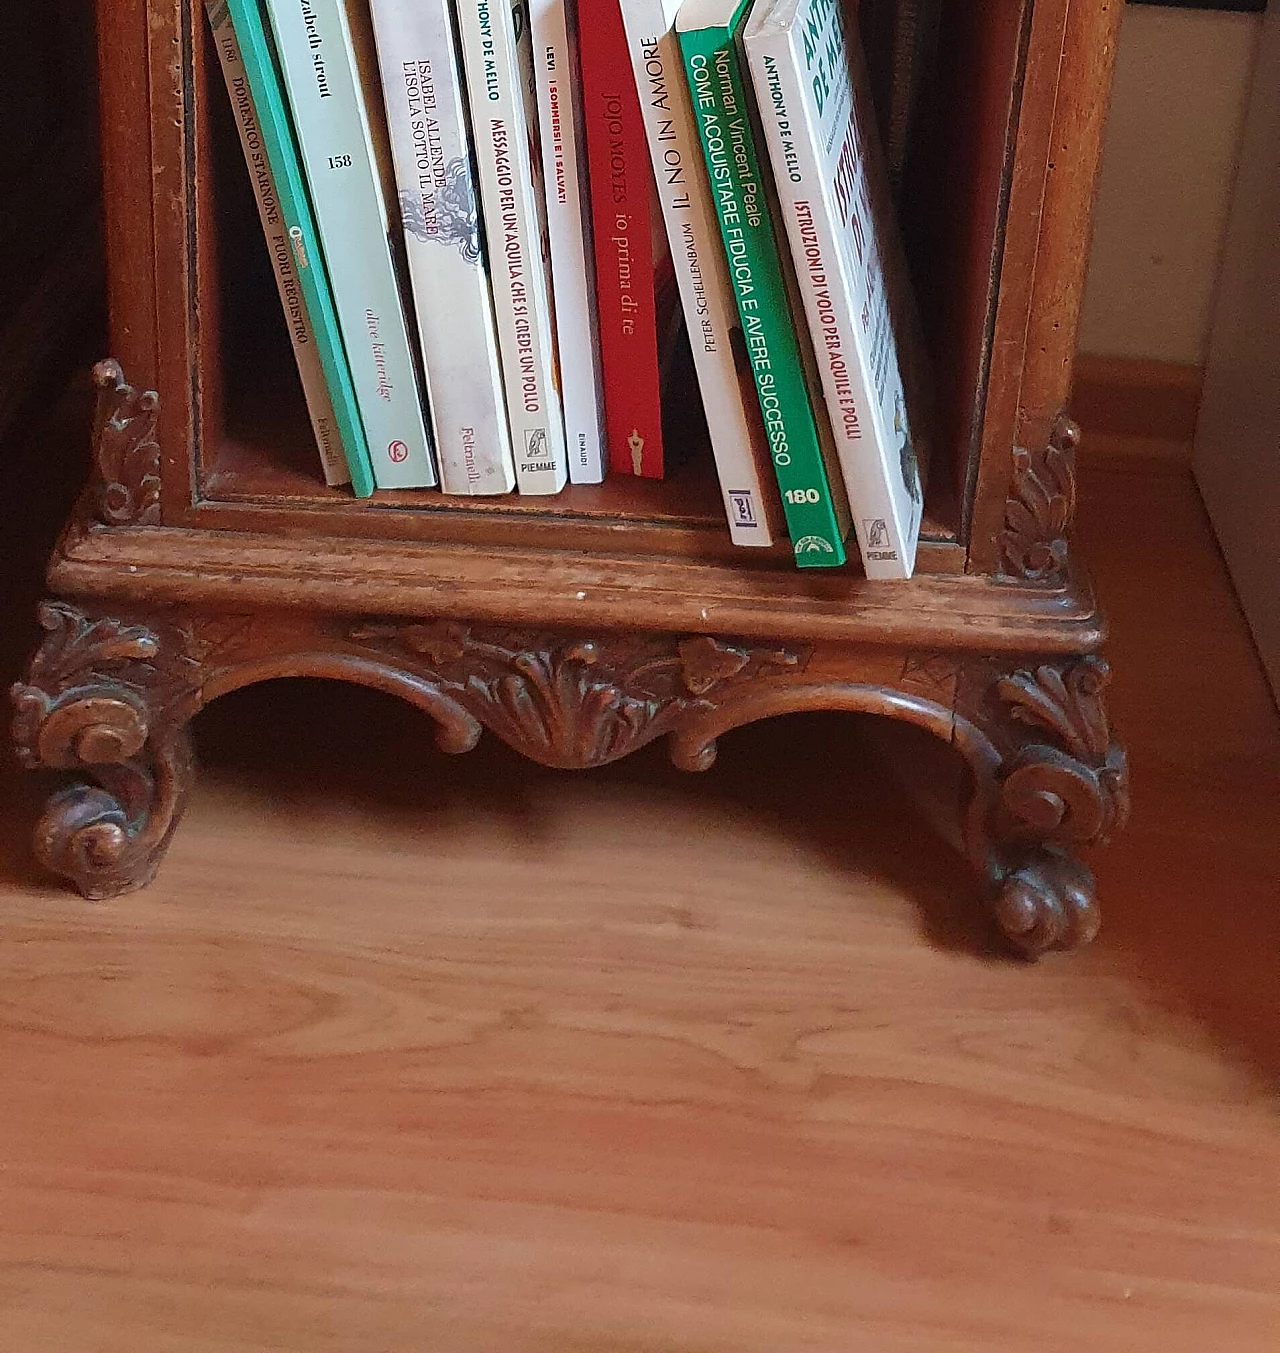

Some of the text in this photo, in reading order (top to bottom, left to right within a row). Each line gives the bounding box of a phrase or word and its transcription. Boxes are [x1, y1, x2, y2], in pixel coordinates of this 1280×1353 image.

[482, 40, 494, 57] DE
[546, 46, 556, 70] LEVI
[312, 53, 332, 99] strout
[484, 60, 500, 101] MELLO
[812, 57, 829, 119] DE
[418, 59, 447, 188] ISABEL ALLENDE
[549, 86, 562, 143] SOMMERSI
[641, 37, 691, 209] IL NO IN AMORE
[714, 49, 761, 227] Norman Vincent Peale
[763, 55, 802, 183] ANTHONY DE MELLO
[327, 155, 352, 169] 158
[403, 61, 439, 235] L'ISOLA SOTTO IL MARE
[555, 161, 567, 204] SALVATI
[231, 76, 260, 152] DOMENICO
[250, 152, 279, 224] STARNONE
[273, 235, 291, 278] FUORI
[283, 279, 308, 344] REGISTRO
[601, 92, 638, 335] JOJO MOYES io prima di te
[689, 53, 791, 467] COME ACQUISTARE FIDUCIA E AVERE SUCCESSO
[794, 200, 824, 273] ISTRUZIONI
[490, 119, 539, 413] MESSAGGIO PER UN'AQUILA CHE SI CREDE UN POLLO
[681, 223, 717, 353] PETER SCHELLENBAUM
[810, 273, 825, 288] DI
[815, 289, 835, 323] VOLO
[365, 308, 394, 402] olive kitteridge
[823, 325, 839, 349] PER
[829, 350, 851, 397] AQUILE
[578, 432, 588, 466] EINAUDI
[841, 406, 862, 440] POLLI
[521, 460, 557, 473] PIEMME
[784, 488, 820, 504] 180
